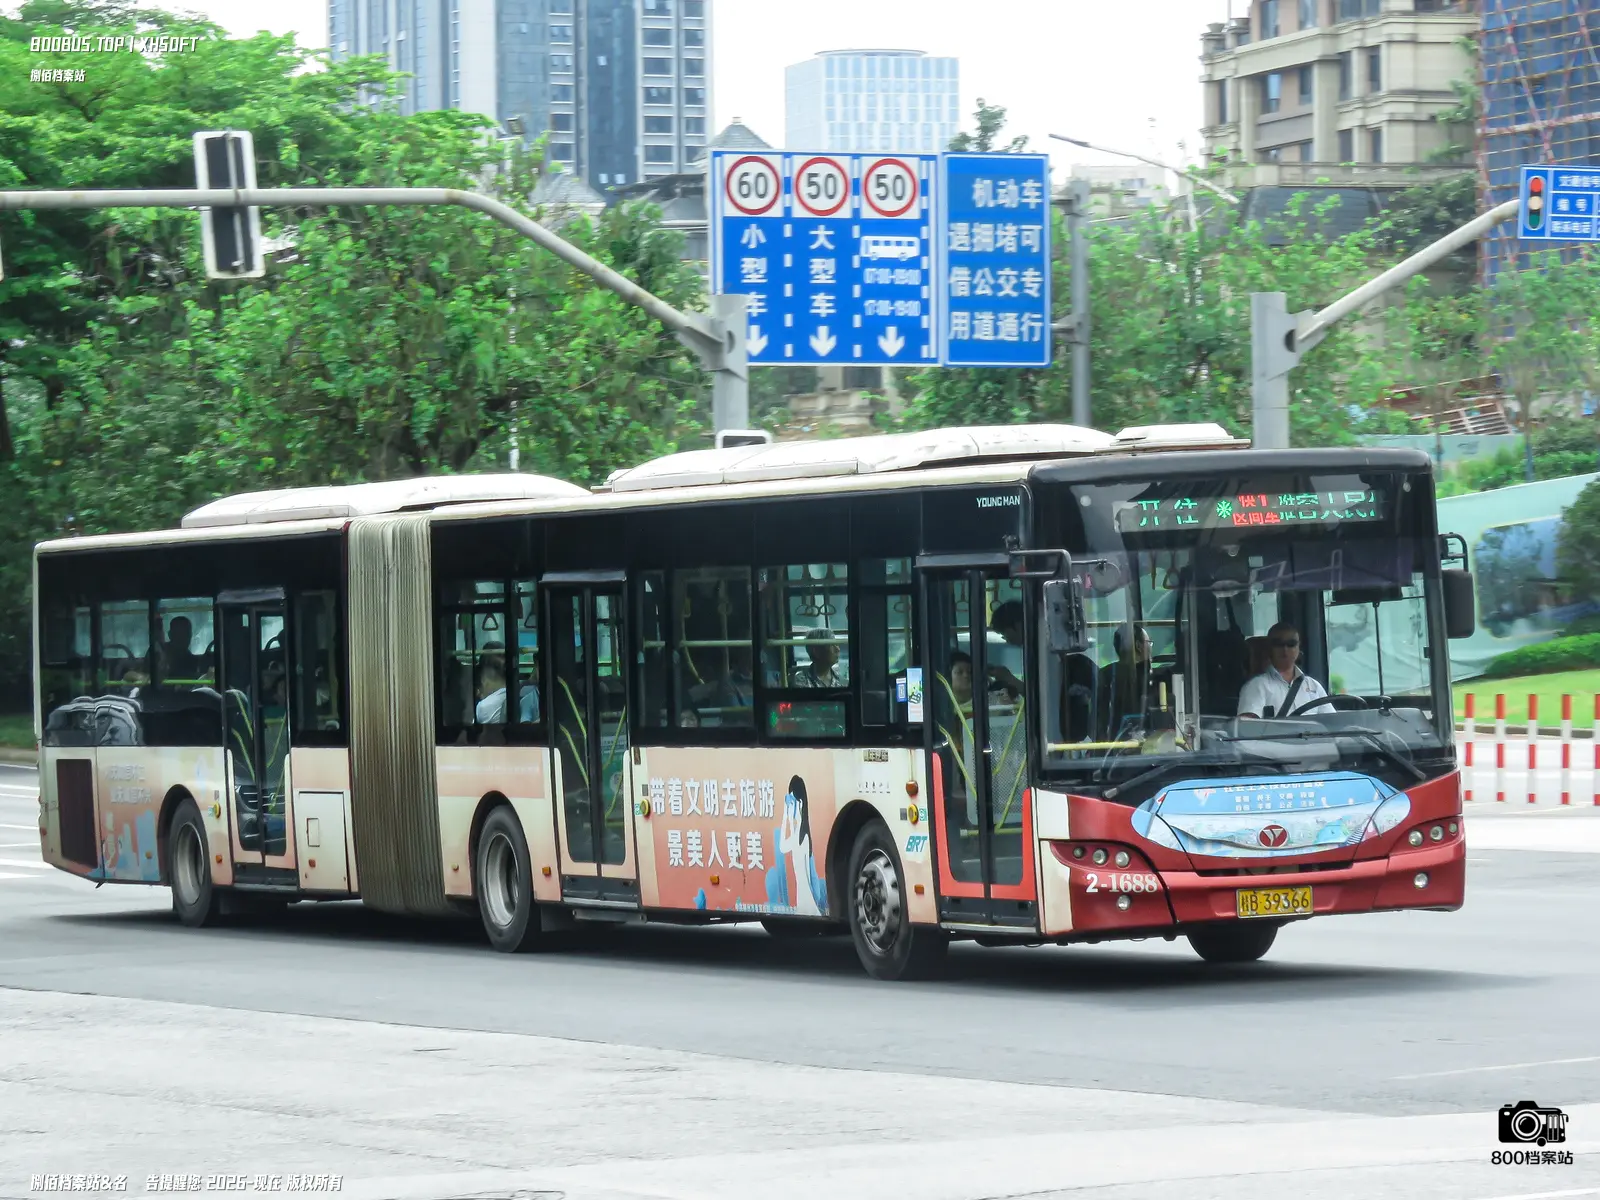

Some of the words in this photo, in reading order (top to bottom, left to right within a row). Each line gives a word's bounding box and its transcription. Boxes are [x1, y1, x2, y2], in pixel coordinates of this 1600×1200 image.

[738, 172, 769, 199] 60
[807, 172, 837, 200] 50
[875, 173, 905, 201] 50
[972, 178, 1043, 209] 机动车
[740, 224, 768, 317] 小型车
[809, 225, 837, 318] 大型车
[948, 266, 1044, 298] 借公交专
[948, 311, 1043, 342] 用道通行
[650, 777, 775, 818] 带着文明去旅游
[667, 829, 765, 870] 景美人更美
[905, 835, 928, 852] BRT
[1086, 873, 1158, 893] 2-1688
